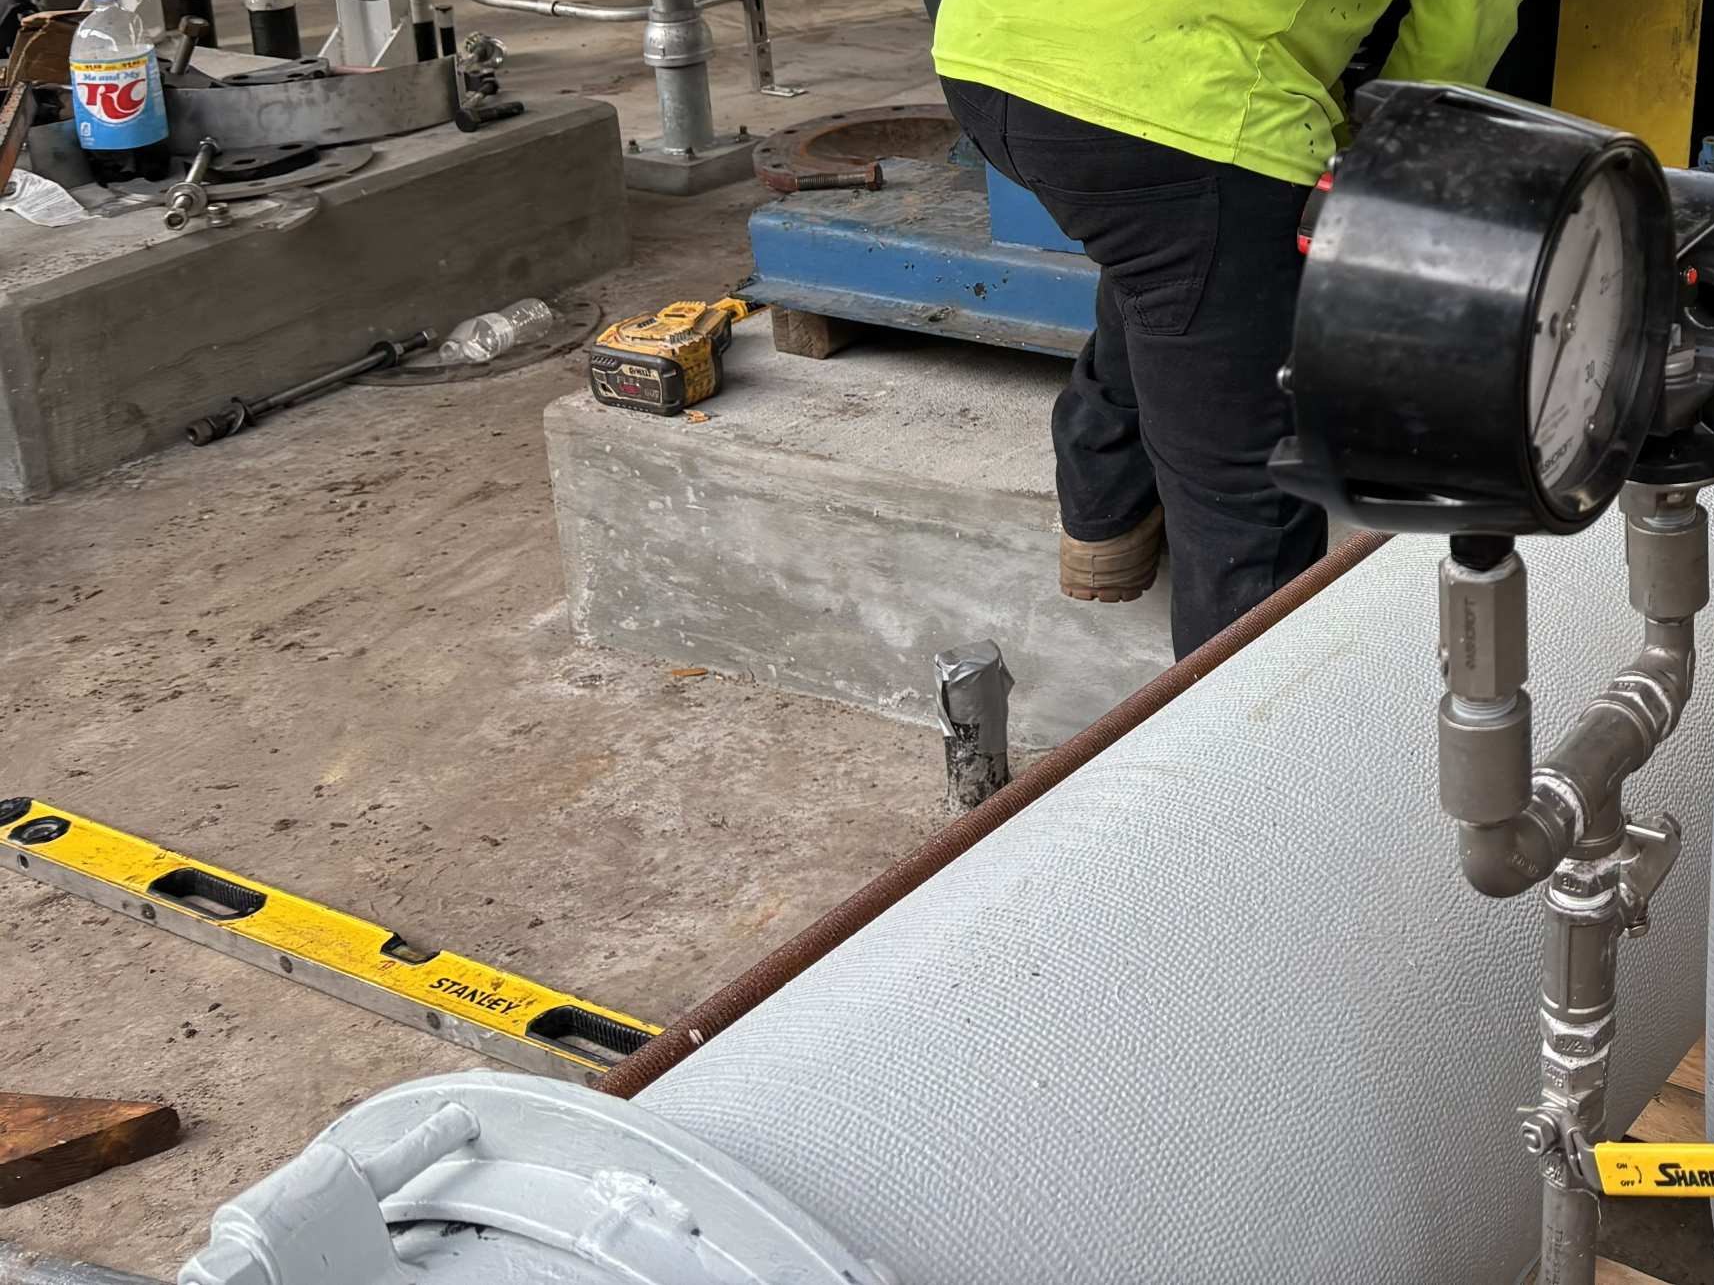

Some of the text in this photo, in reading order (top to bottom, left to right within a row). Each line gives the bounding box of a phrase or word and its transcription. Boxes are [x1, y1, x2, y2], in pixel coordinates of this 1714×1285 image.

[76, 78, 147, 120] RC
[1584, 359, 1596, 384] 30
[428, 977, 522, 1015] STANLEY
[1616, 1162, 1628, 1170] ON
[1620, 1179, 1636, 1188] OFF
